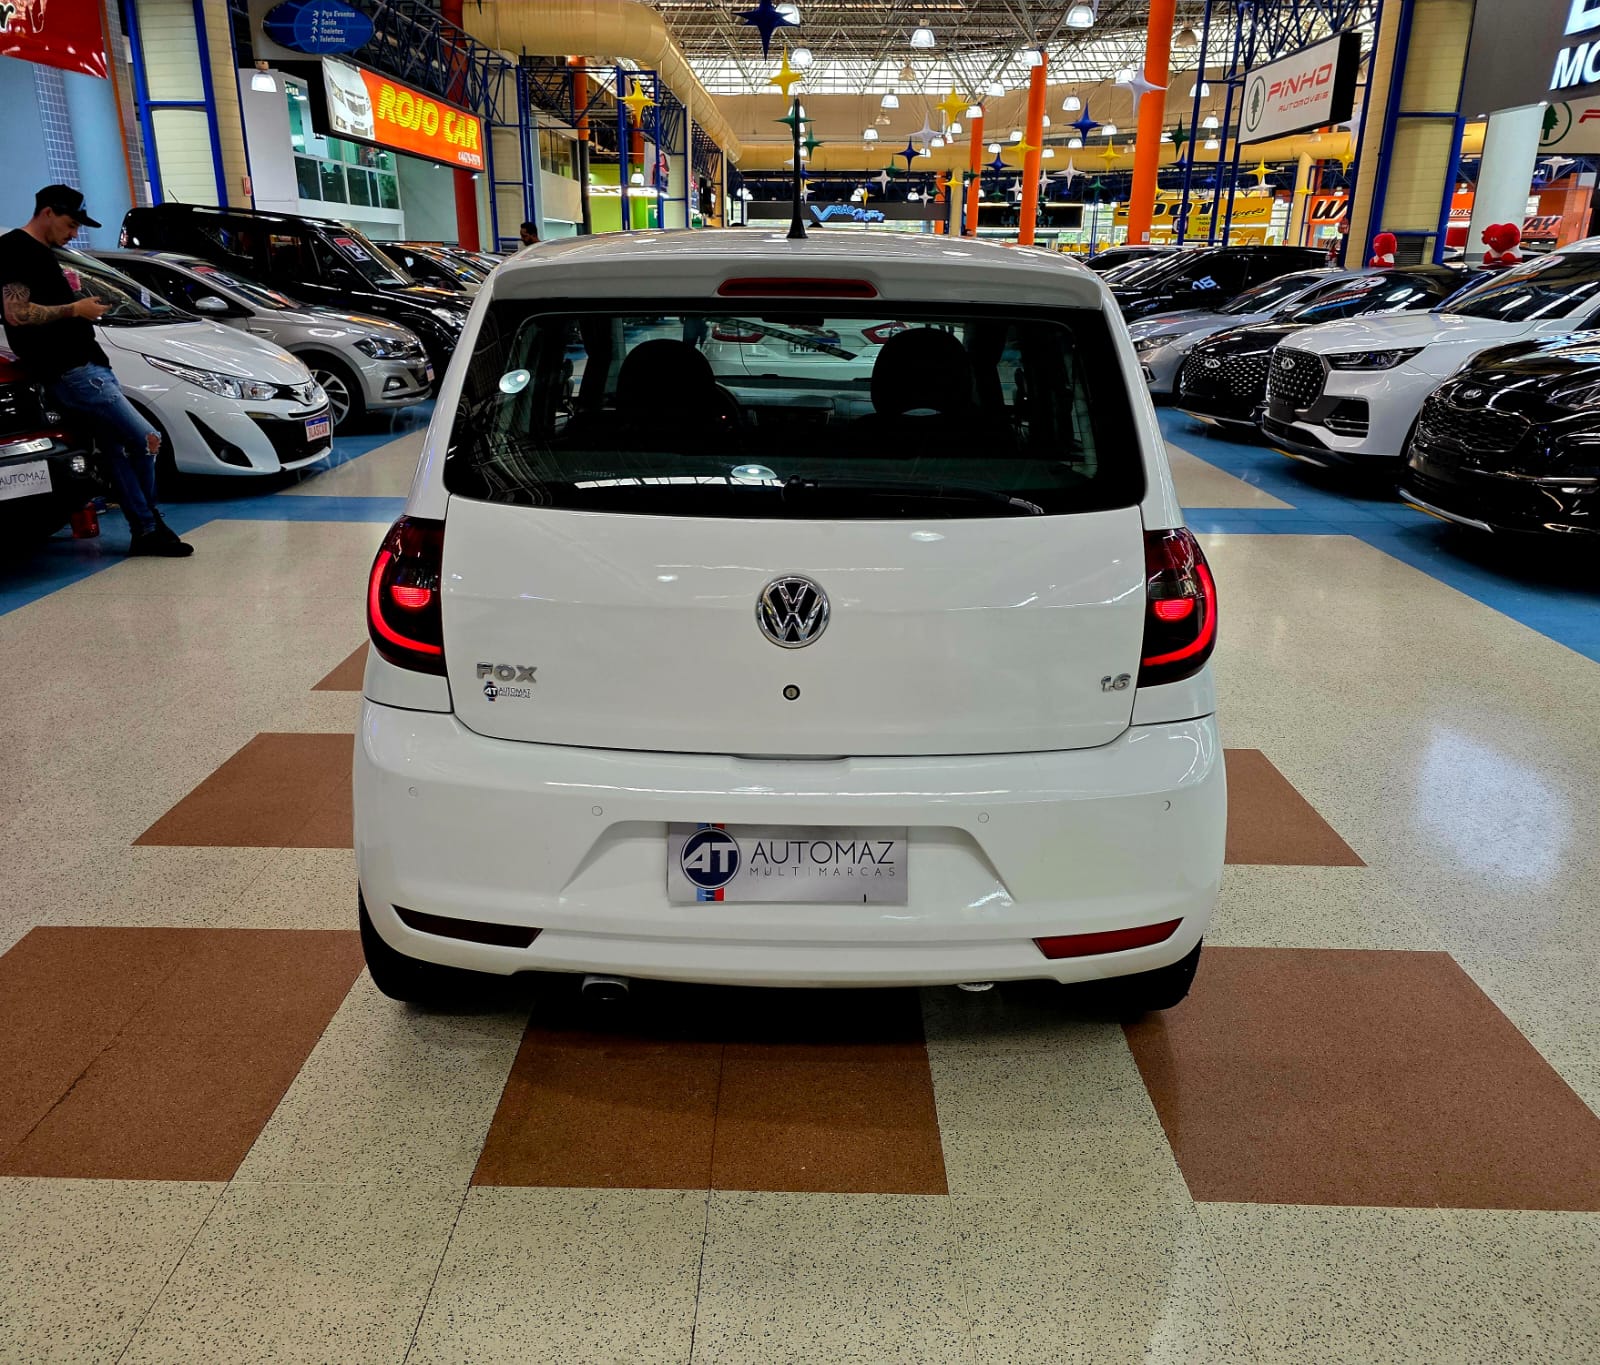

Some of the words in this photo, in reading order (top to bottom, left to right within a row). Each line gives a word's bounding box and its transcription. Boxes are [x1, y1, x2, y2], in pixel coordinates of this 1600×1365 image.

[1267, 63, 1333, 102] PINHO
[377, 83, 440, 136] ROJO
[443, 110, 478, 150] CAR
[477, 662, 537, 683] FOX
[683, 842, 738, 873] AT
[750, 841, 895, 865] AUTOMAZ
[750, 866, 896, 877] MULTIMARCAS
